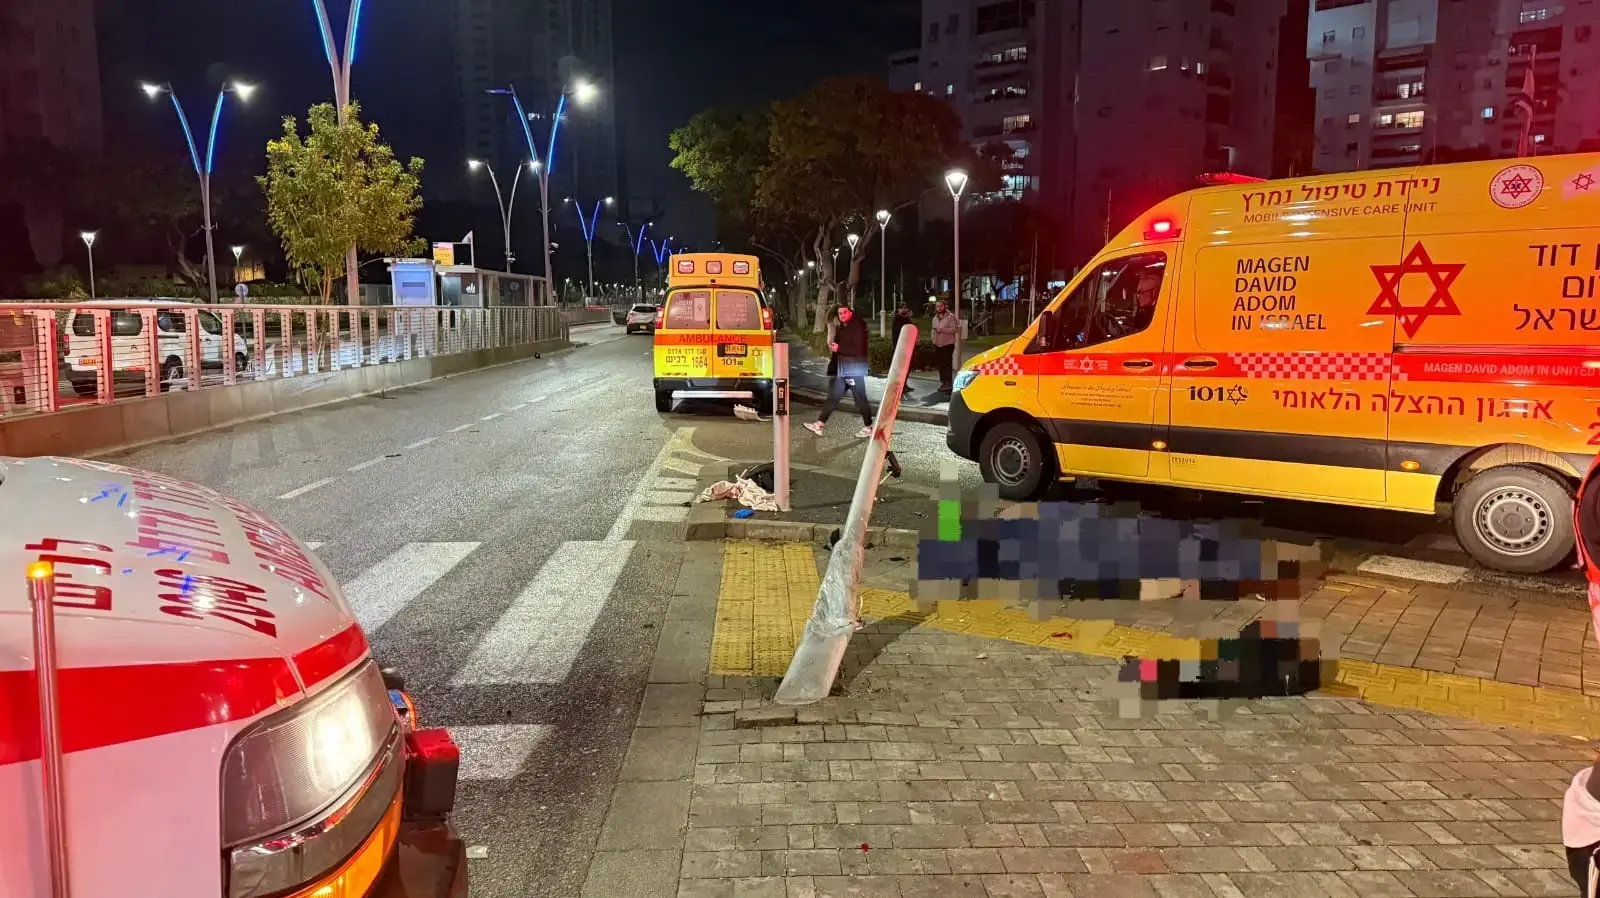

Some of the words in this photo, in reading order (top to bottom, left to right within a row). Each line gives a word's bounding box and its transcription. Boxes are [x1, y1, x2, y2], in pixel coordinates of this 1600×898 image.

[1301, 184, 1367, 202] טיפול
[1374, 177, 1441, 198] ניידת
[1242, 189, 1293, 213] נמרץ
[1291, 206, 1360, 219] ENSIVE
[1363, 204, 1399, 215] CARE
[1403, 201, 1437, 213] UNIT
[1529, 243, 1581, 267] דוד
[1237, 255, 1309, 274] MAGEN
[1235, 275, 1296, 292] DAVID
[1562, 275, 1600, 298] ום
[1233, 295, 1296, 312] ADOM
[1231, 315, 1251, 330] IN
[1260, 314, 1327, 330] ISRAEL
[1513, 303, 1600, 331] שראל
[679, 334, 747, 343] AMBULANCE
[722, 358, 737, 366] 101
[1424, 363, 1462, 374] MAGEN
[1464, 364, 1497, 374] DAVID
[1499, 365, 1534, 375] ADOM
[1537, 365, 1549, 375] IN
[1552, 366, 1595, 376] UNITED
[1187, 386, 1225, 402] 101
[1273, 387, 1361, 411] הלאומי
[1371, 389, 1465, 416] ההצלה
